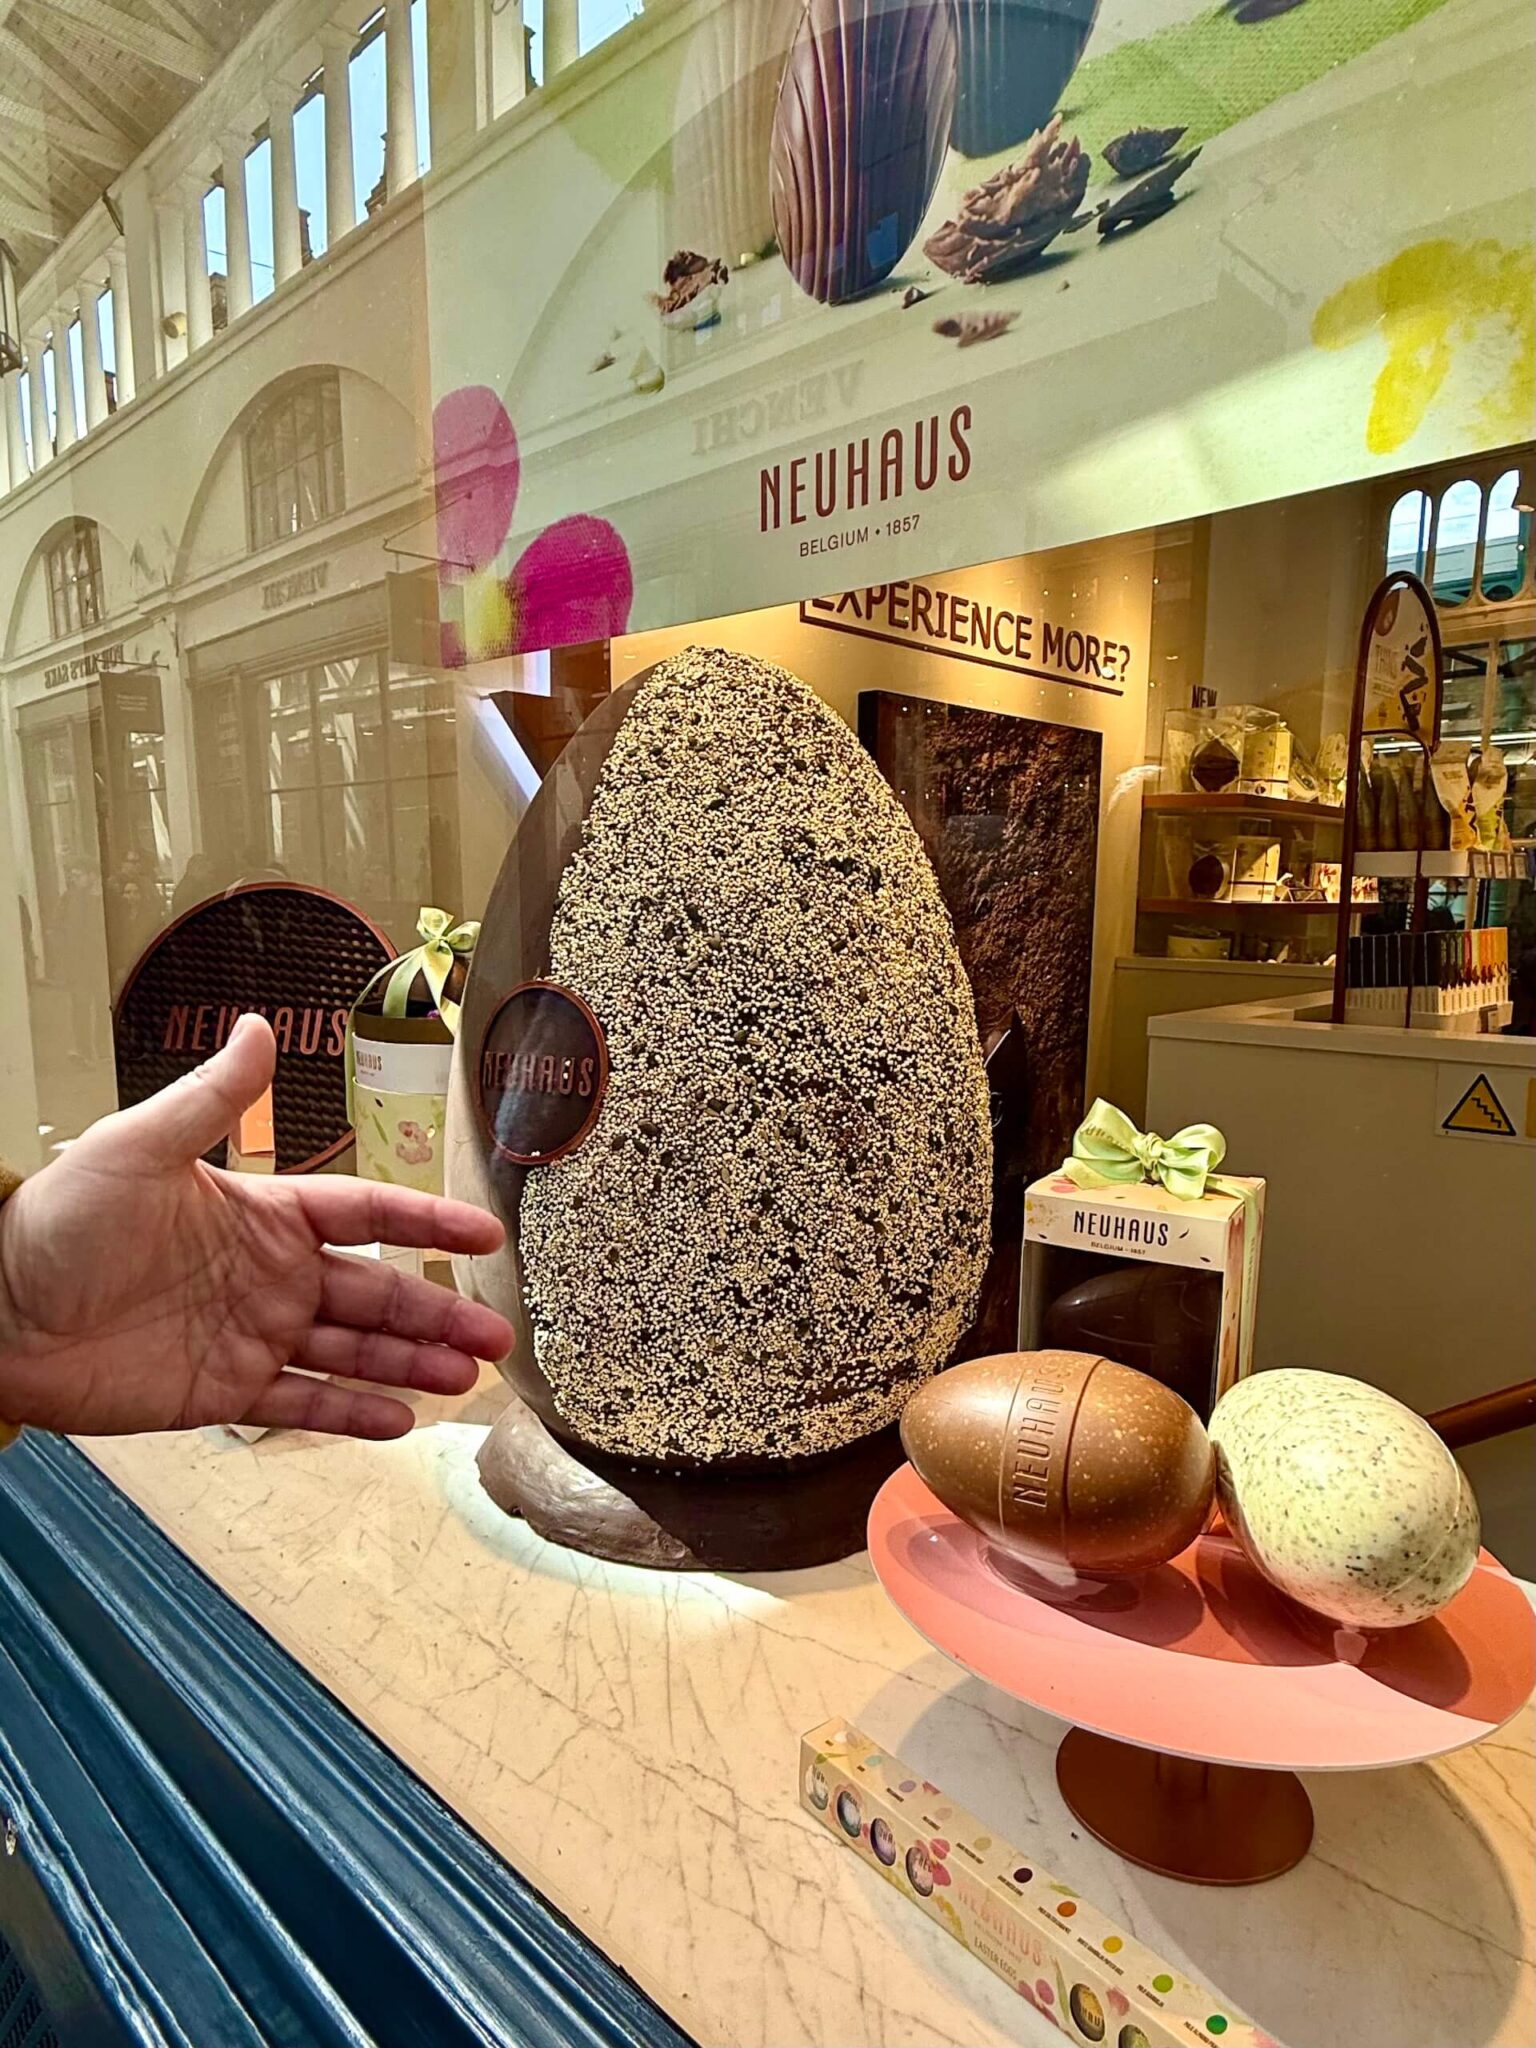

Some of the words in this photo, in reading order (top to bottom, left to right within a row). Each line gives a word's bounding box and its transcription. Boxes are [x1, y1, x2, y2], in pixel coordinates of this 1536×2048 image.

[760, 404, 972, 532] NEUHAUS
[800, 526, 869, 557] BELGIUM
[886, 514, 920, 536] 1857
[1042, 622, 1131, 682] MORE?
[164, 1004, 347, 1057] NEUAUS
[1073, 1210, 1169, 1246] NEUHAUS
[1012, 1358, 1071, 1508] NEUHAUS
